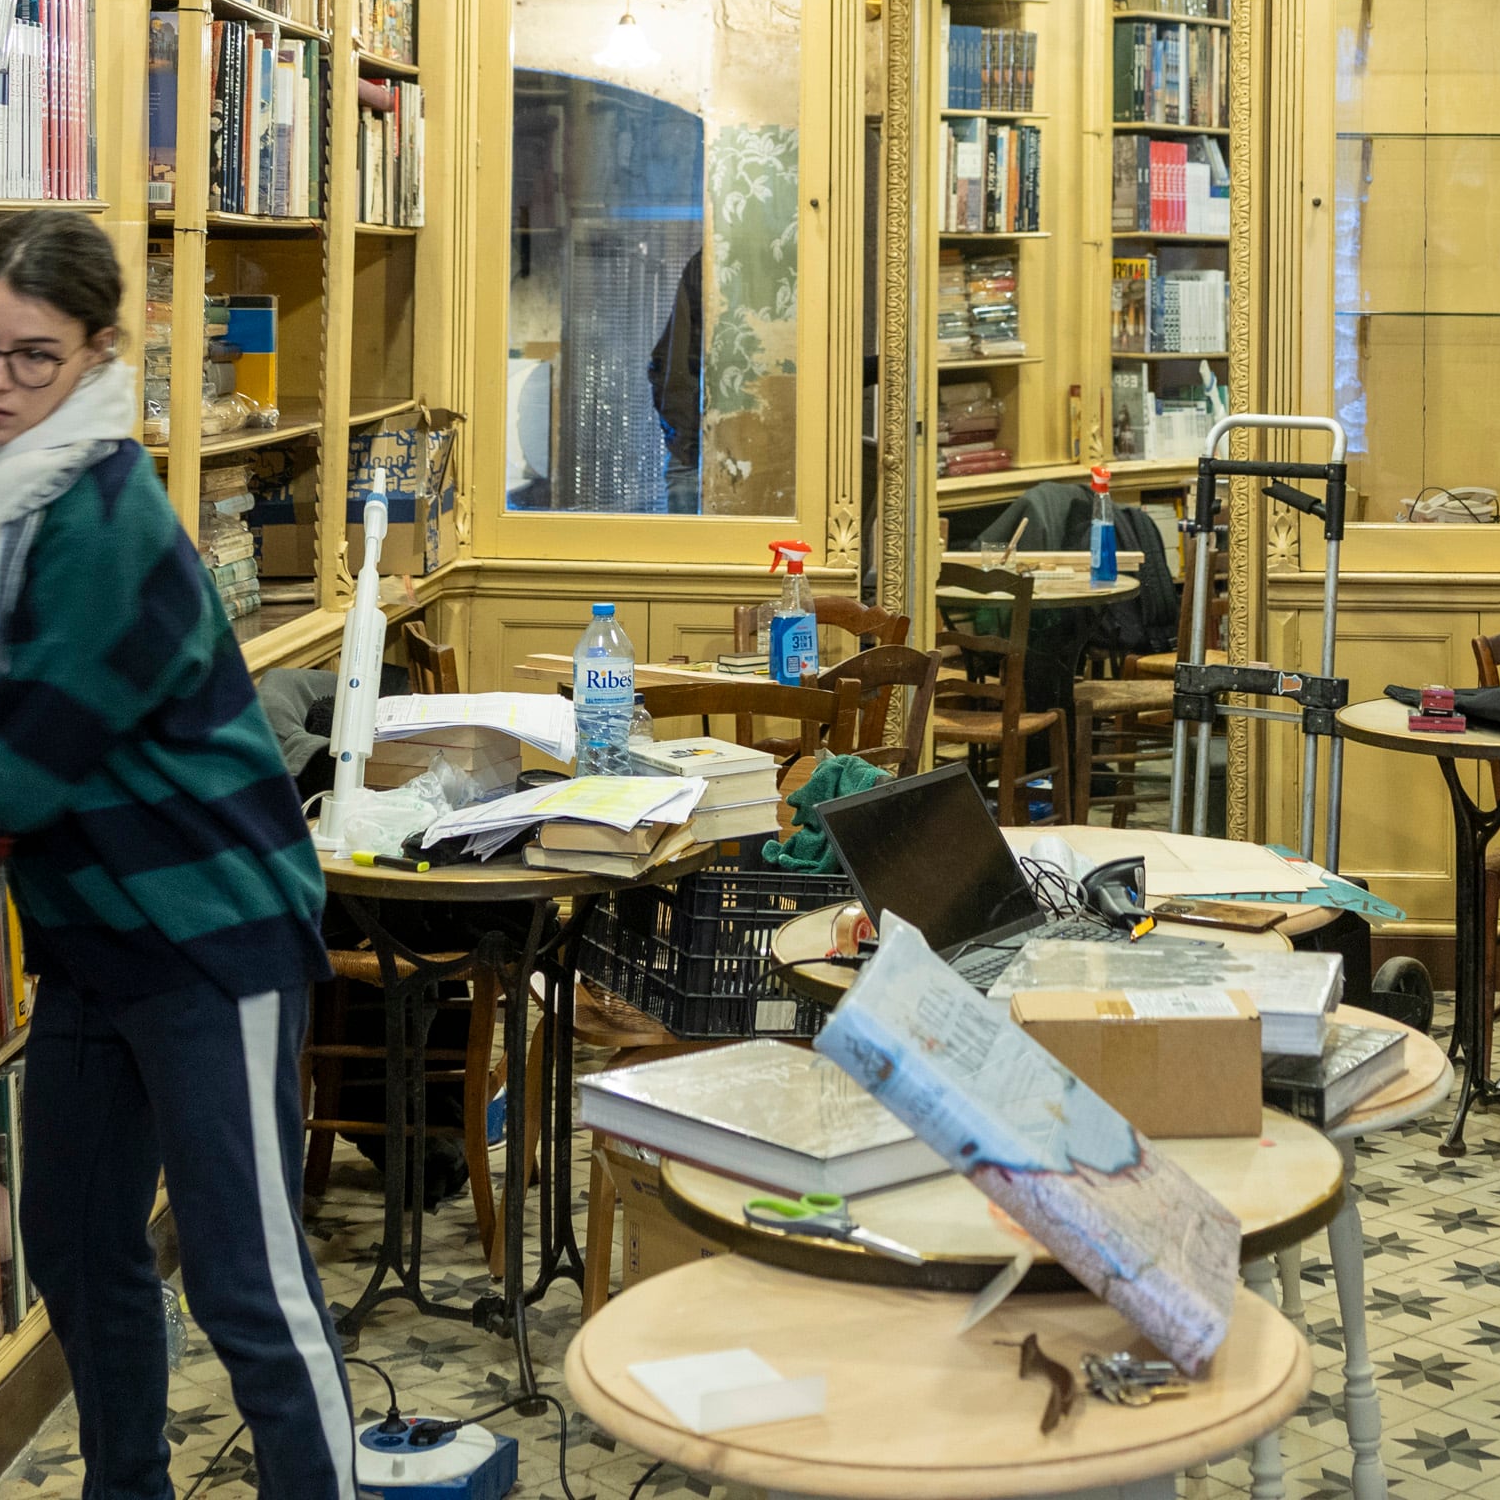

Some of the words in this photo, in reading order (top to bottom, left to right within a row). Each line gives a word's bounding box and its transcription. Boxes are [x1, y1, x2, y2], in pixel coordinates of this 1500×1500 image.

[792, 635, 800, 649] 3
[807, 635, 813, 648] 1
[586, 669, 632, 689] Ribes
